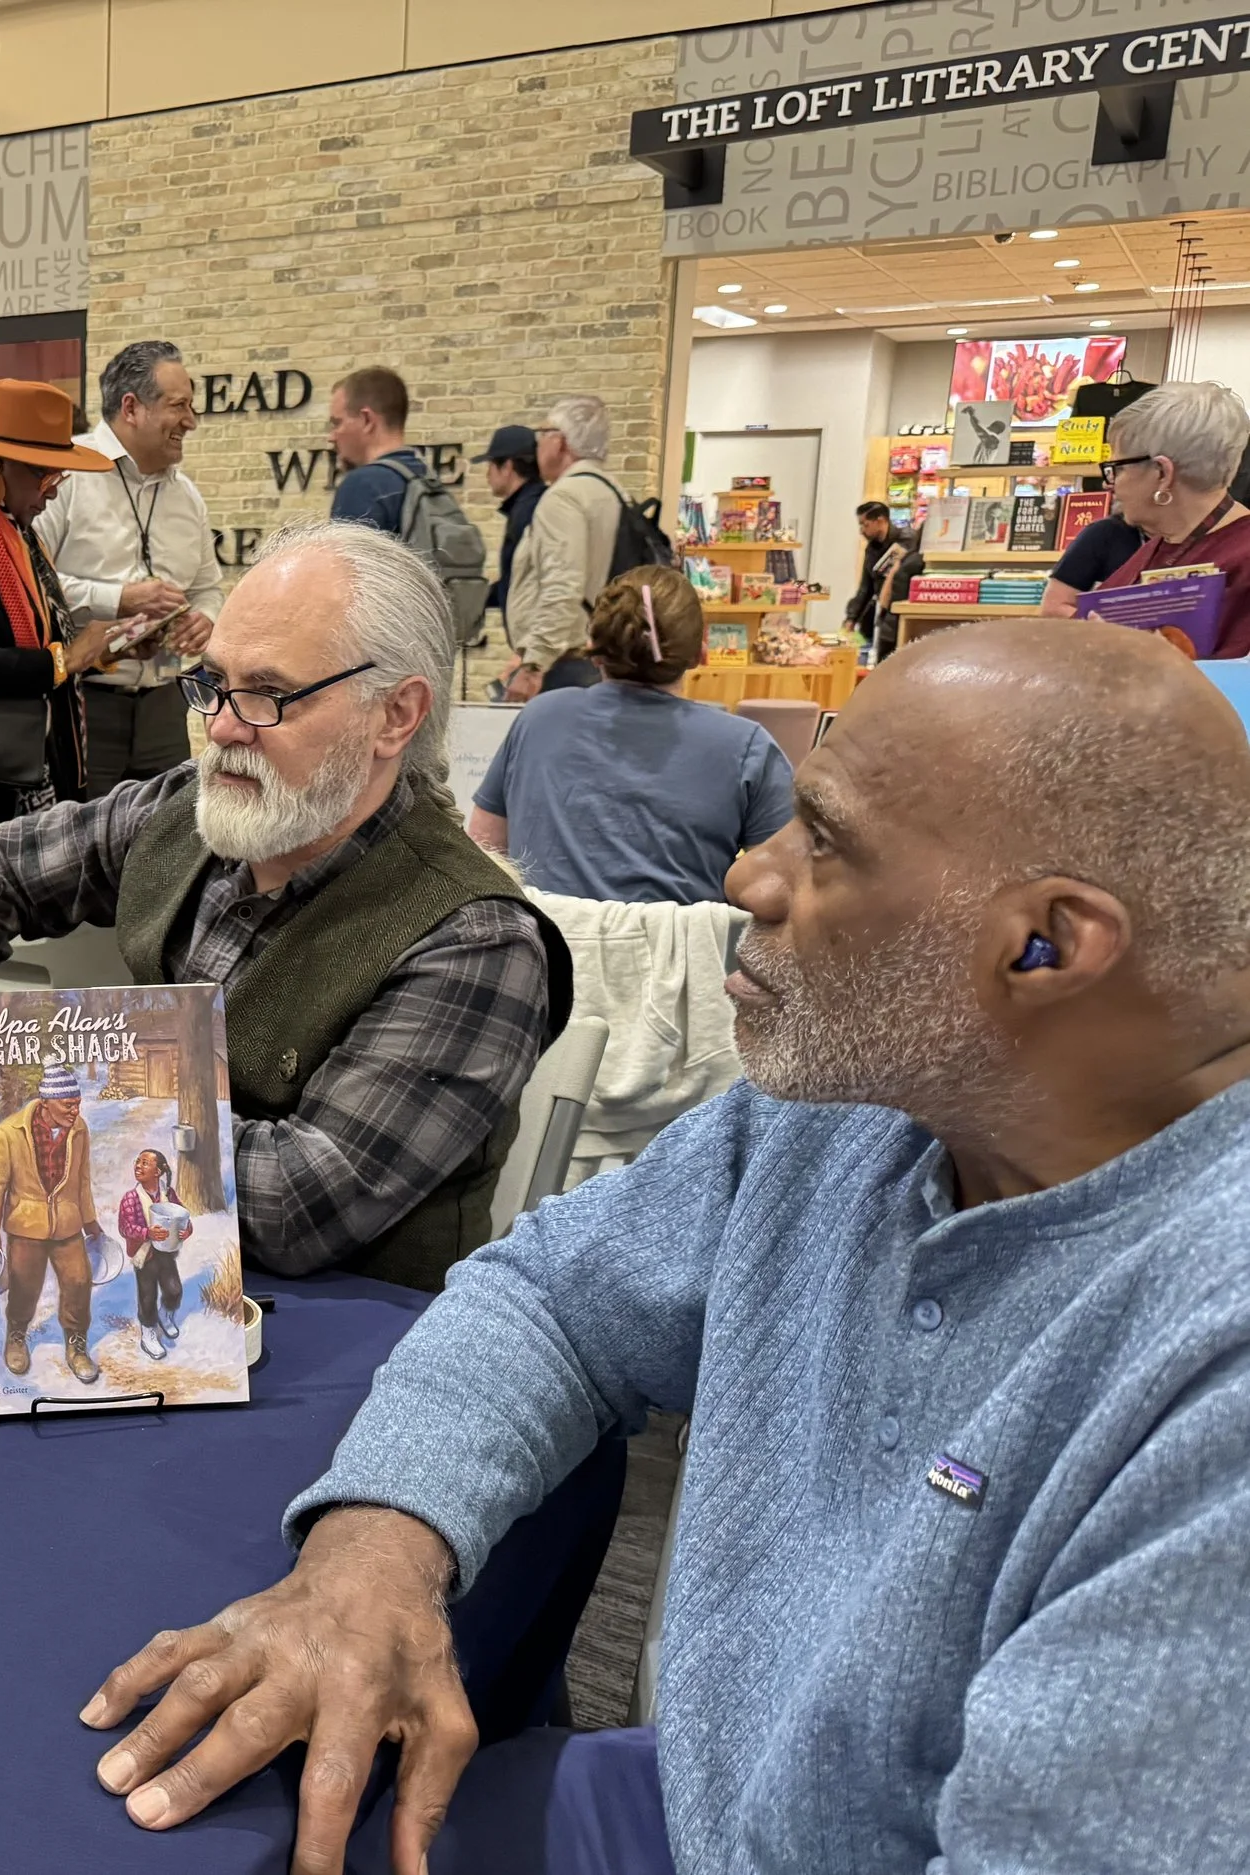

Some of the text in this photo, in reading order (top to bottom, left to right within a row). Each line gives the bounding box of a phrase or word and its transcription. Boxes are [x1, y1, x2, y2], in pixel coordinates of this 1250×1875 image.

[662, 100, 741, 143] THE
[751, 81, 862, 131] LOFT
[872, 42, 1109, 113] LITERARY
[933, 145, 1221, 202] BIBLIOGRAPHY
[191, 369, 313, 417] EAD
[1062, 420, 1099, 432] Sticky
[1061, 444, 1095, 455] Notes
[918, 580, 961, 589] ATWOOD
[916, 592, 960, 602] ATWOOD
[47, 1006, 127, 1033] Alan's
[50, 1032, 139, 1064] SHACK
[2, 1386, 28, 1395] Geister
